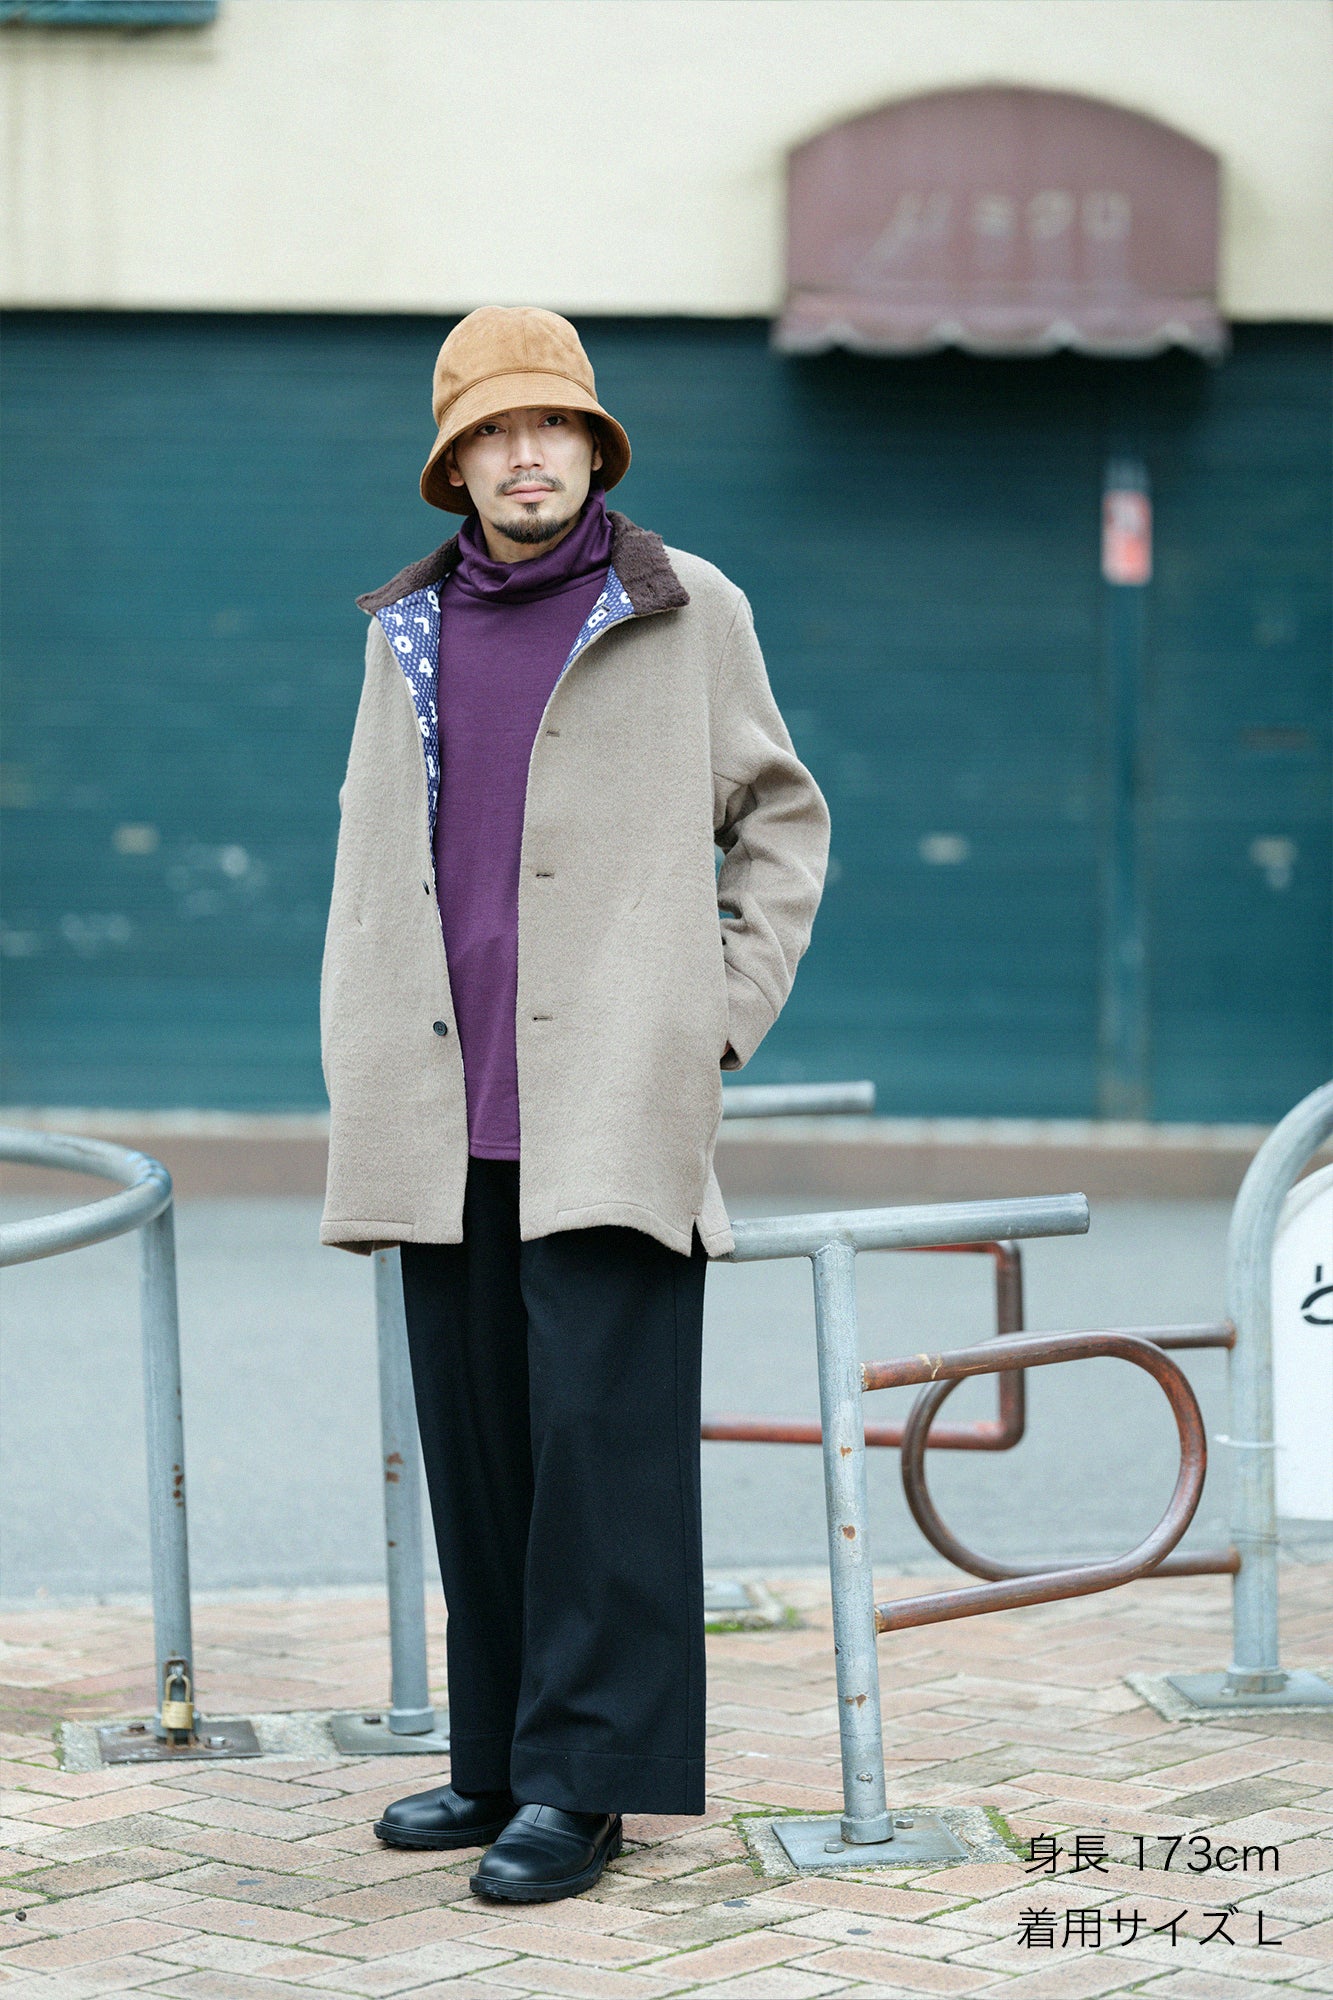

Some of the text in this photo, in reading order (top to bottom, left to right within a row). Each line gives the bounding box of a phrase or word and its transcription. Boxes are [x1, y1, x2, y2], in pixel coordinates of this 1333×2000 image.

[419, 657, 434, 678] 4
[418, 716, 430, 738] 6
[427, 755, 436, 777] 8
